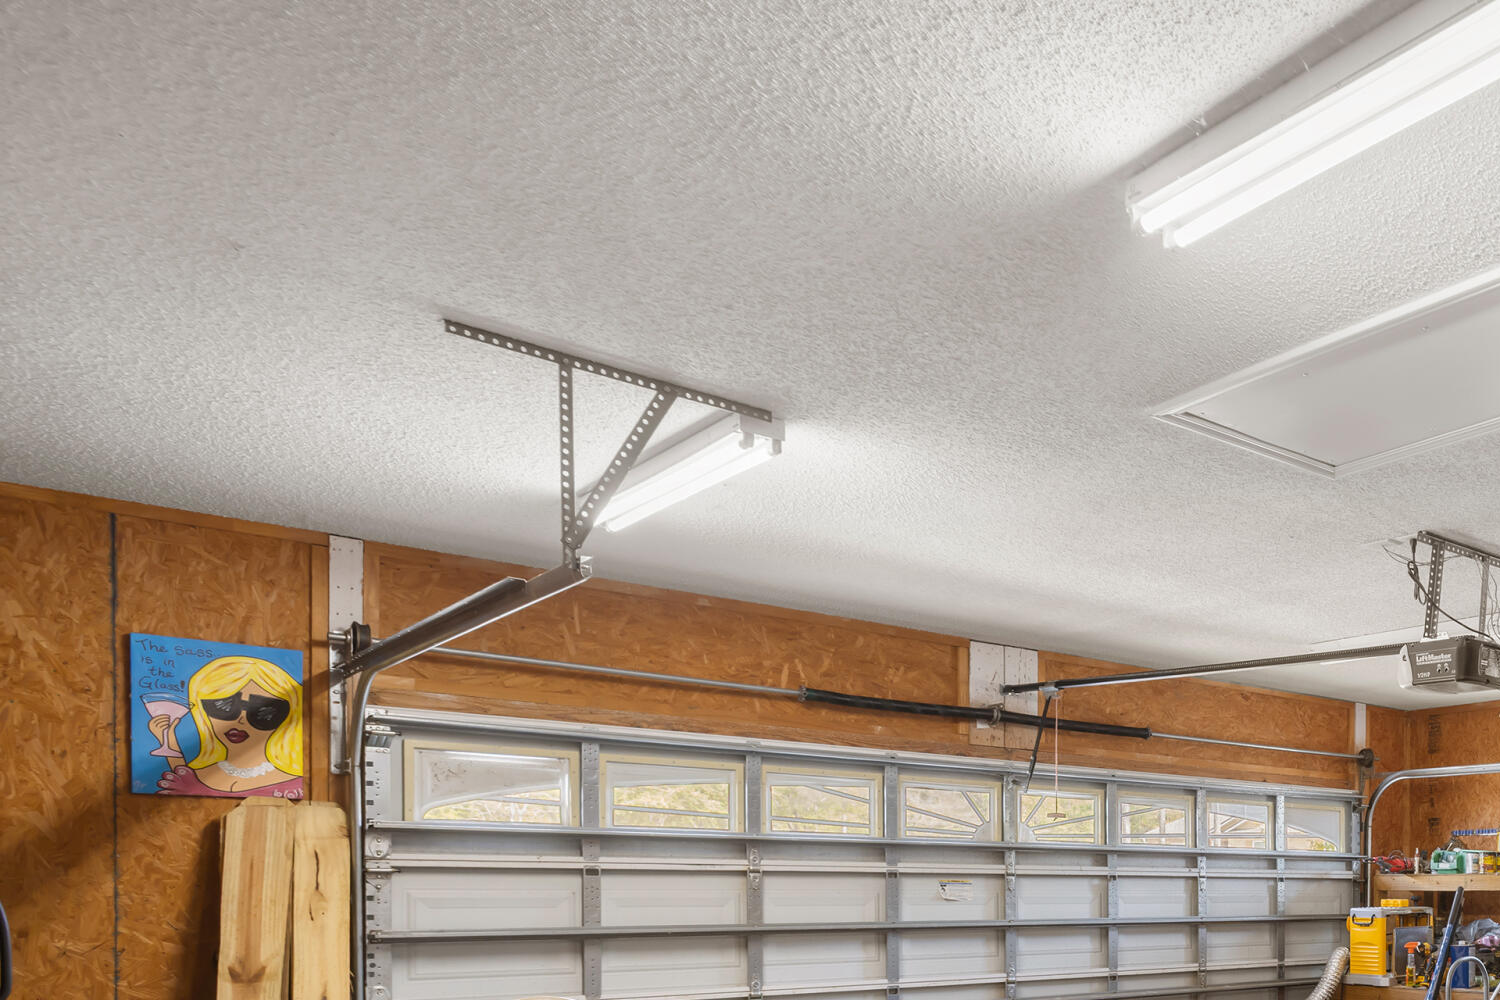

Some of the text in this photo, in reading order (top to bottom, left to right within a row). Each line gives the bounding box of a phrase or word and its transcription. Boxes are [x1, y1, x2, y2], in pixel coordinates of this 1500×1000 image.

[135, 638, 168, 654] The
[141, 656, 175, 669] is in
[1415, 653, 1452, 662] LiftMaster
[149, 666, 175, 678] the
[138, 676, 186, 693] Glass!
